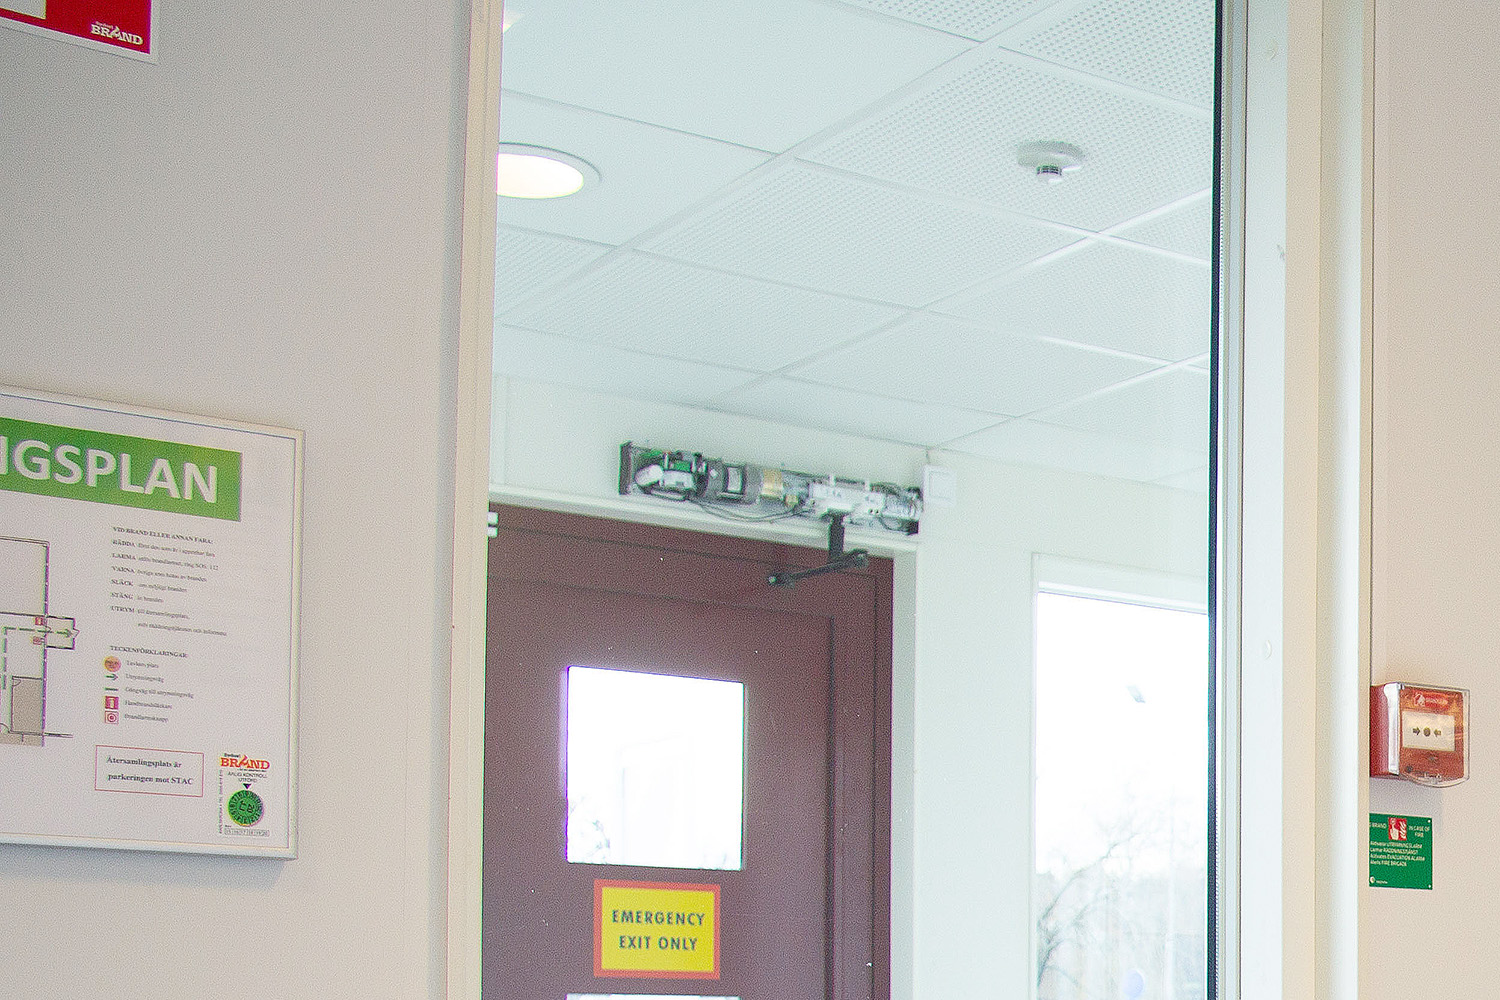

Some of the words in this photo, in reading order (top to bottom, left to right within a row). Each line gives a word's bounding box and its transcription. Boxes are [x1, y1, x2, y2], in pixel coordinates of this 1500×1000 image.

[611, 910, 705, 925] EMERGENCY
[619, 935, 651, 949] EXIT
[658, 936, 698, 950] ONLY
